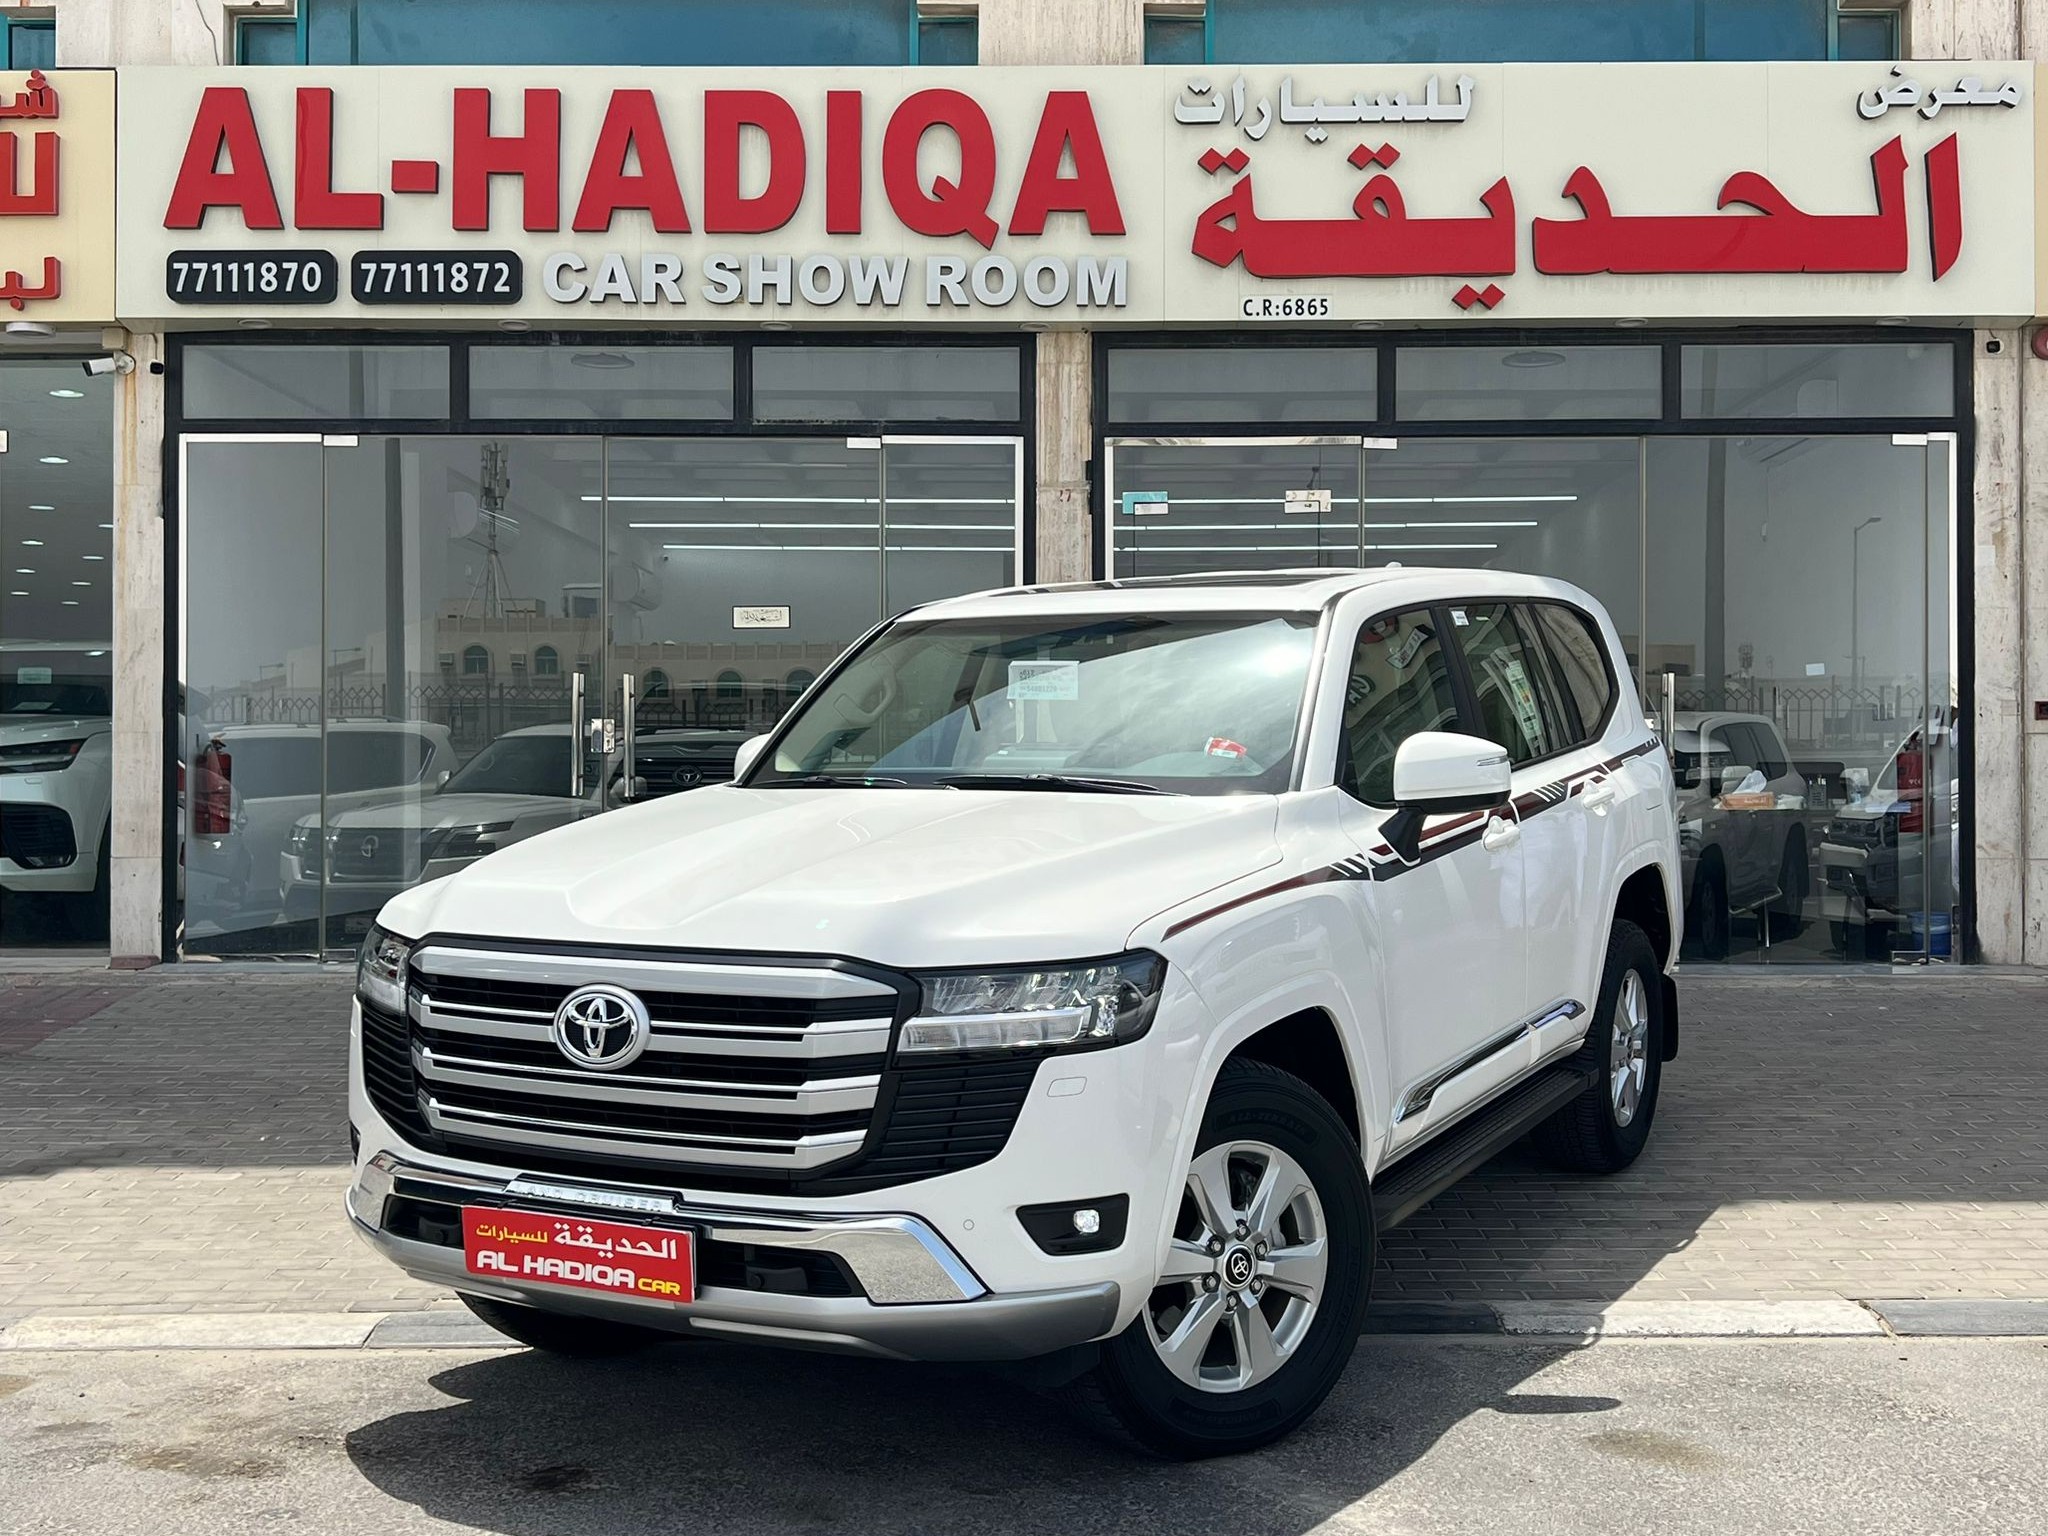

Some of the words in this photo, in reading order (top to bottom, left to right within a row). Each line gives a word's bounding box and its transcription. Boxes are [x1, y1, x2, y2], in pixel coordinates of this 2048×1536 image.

[1174, 73, 1476, 143] للسيارات
[1857, 65, 2024, 121] معرض
[163, 86, 1127, 250] AL-HADIQA
[1191, 131, 1963, 311] الحديقة
[172, 261, 322, 293] 77111870
[359, 261, 511, 293] 77111872
[543, 252, 686, 304] CAR
[702, 253, 909, 306] SHOW
[926, 255, 1128, 307] ROOM
[1242, 298, 1329, 317] C.R:6865
[475, 1223, 548, 1244] للسيارات
[553, 1221, 677, 1260] الحديقة
[476, 1249, 519, 1273] AL
[523, 1253, 636, 1289] HADIQA
[637, 1277, 681, 1296] CAR
